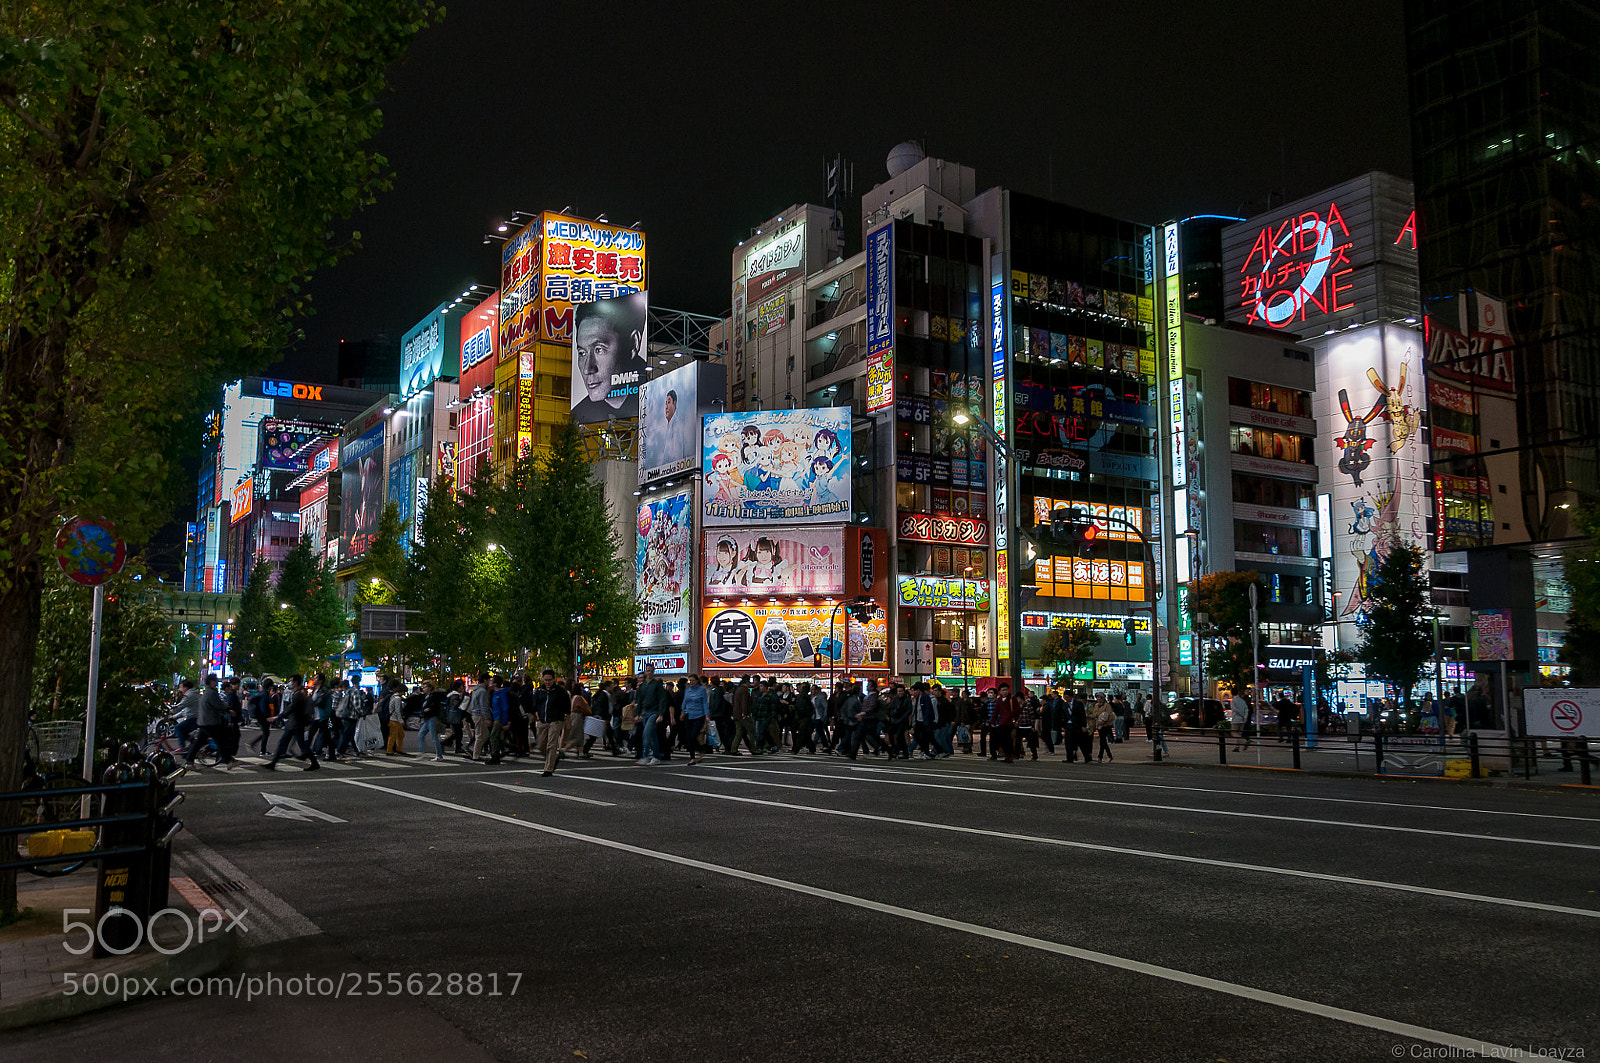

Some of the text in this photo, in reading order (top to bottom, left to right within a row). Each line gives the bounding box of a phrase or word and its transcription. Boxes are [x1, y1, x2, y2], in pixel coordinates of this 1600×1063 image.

[1241, 202, 1350, 273] AKIBA
[547, 241, 643, 281] 激安販売
[750, 234, 801, 278] メイドカジノ
[1241, 243, 1353, 297] カルチャーズ
[462, 326, 493, 371] SEGA
[868, 366, 892, 384] まんが
[608, 384, 638, 398] .make
[914, 408, 931, 422] 6F
[916, 468, 931, 480] 5F
[902, 517, 986, 542] メイドカジノ
[1074, 562, 1124, 584] あみあみ
[900, 578, 977, 601] まんが喫茶
[917, 596, 948, 606] ゲラゲラ
[1323, 560, 1333, 620] GALLERIA
[1026, 615, 1045, 626] 買取
[1134, 620, 1147, 630] ニメ
[713, 617, 751, 656] 質
